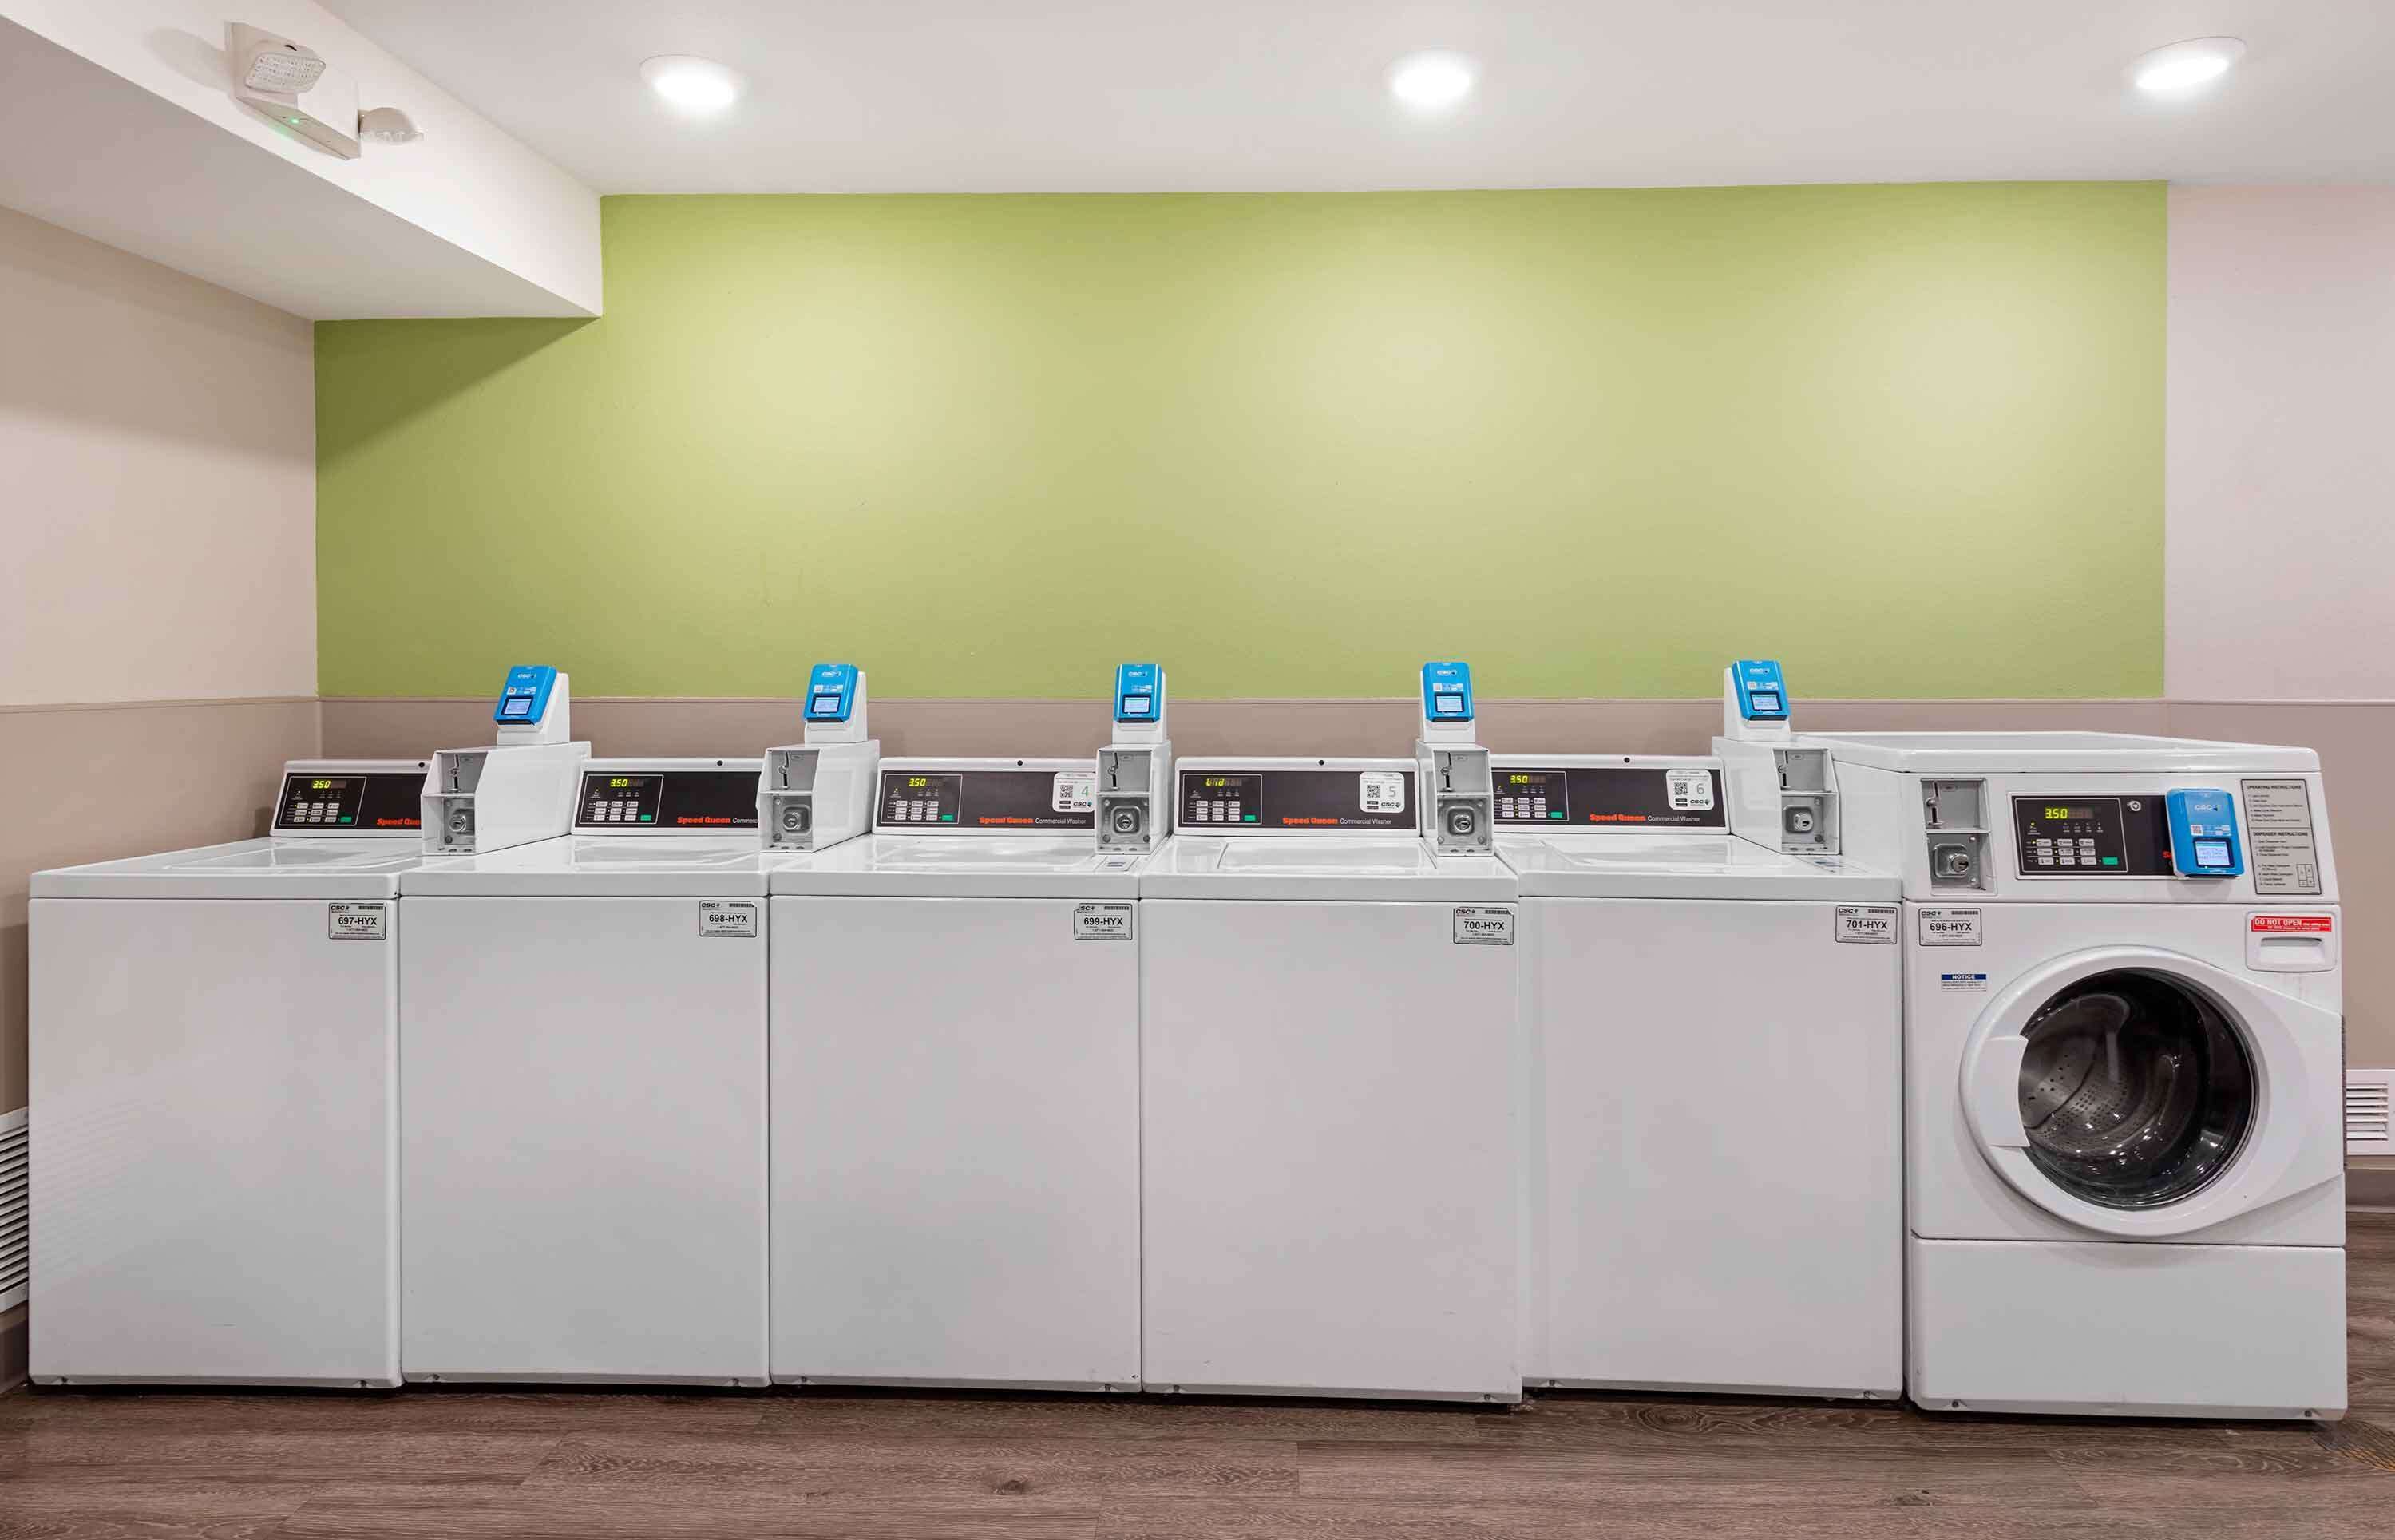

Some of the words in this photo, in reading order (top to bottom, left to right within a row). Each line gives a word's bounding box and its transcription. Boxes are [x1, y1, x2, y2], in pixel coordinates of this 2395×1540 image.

[1081, 786, 1089, 797] 4
[1388, 786, 1397, 798] 5
[1696, 783, 1705, 795] 6
[1589, 813, 1617, 821] Speed
[377, 818, 404, 827] Speed
[338, 916, 378, 926] 697-HYX
[709, 914, 748, 923] 698-HYX
[1083, 917, 1124, 926] 699-HYX
[1463, 921, 1505, 930] 700-HYX
[1846, 920, 1888, 929] 701-HYX
[1930, 922, 1973, 931] 696-HYX
